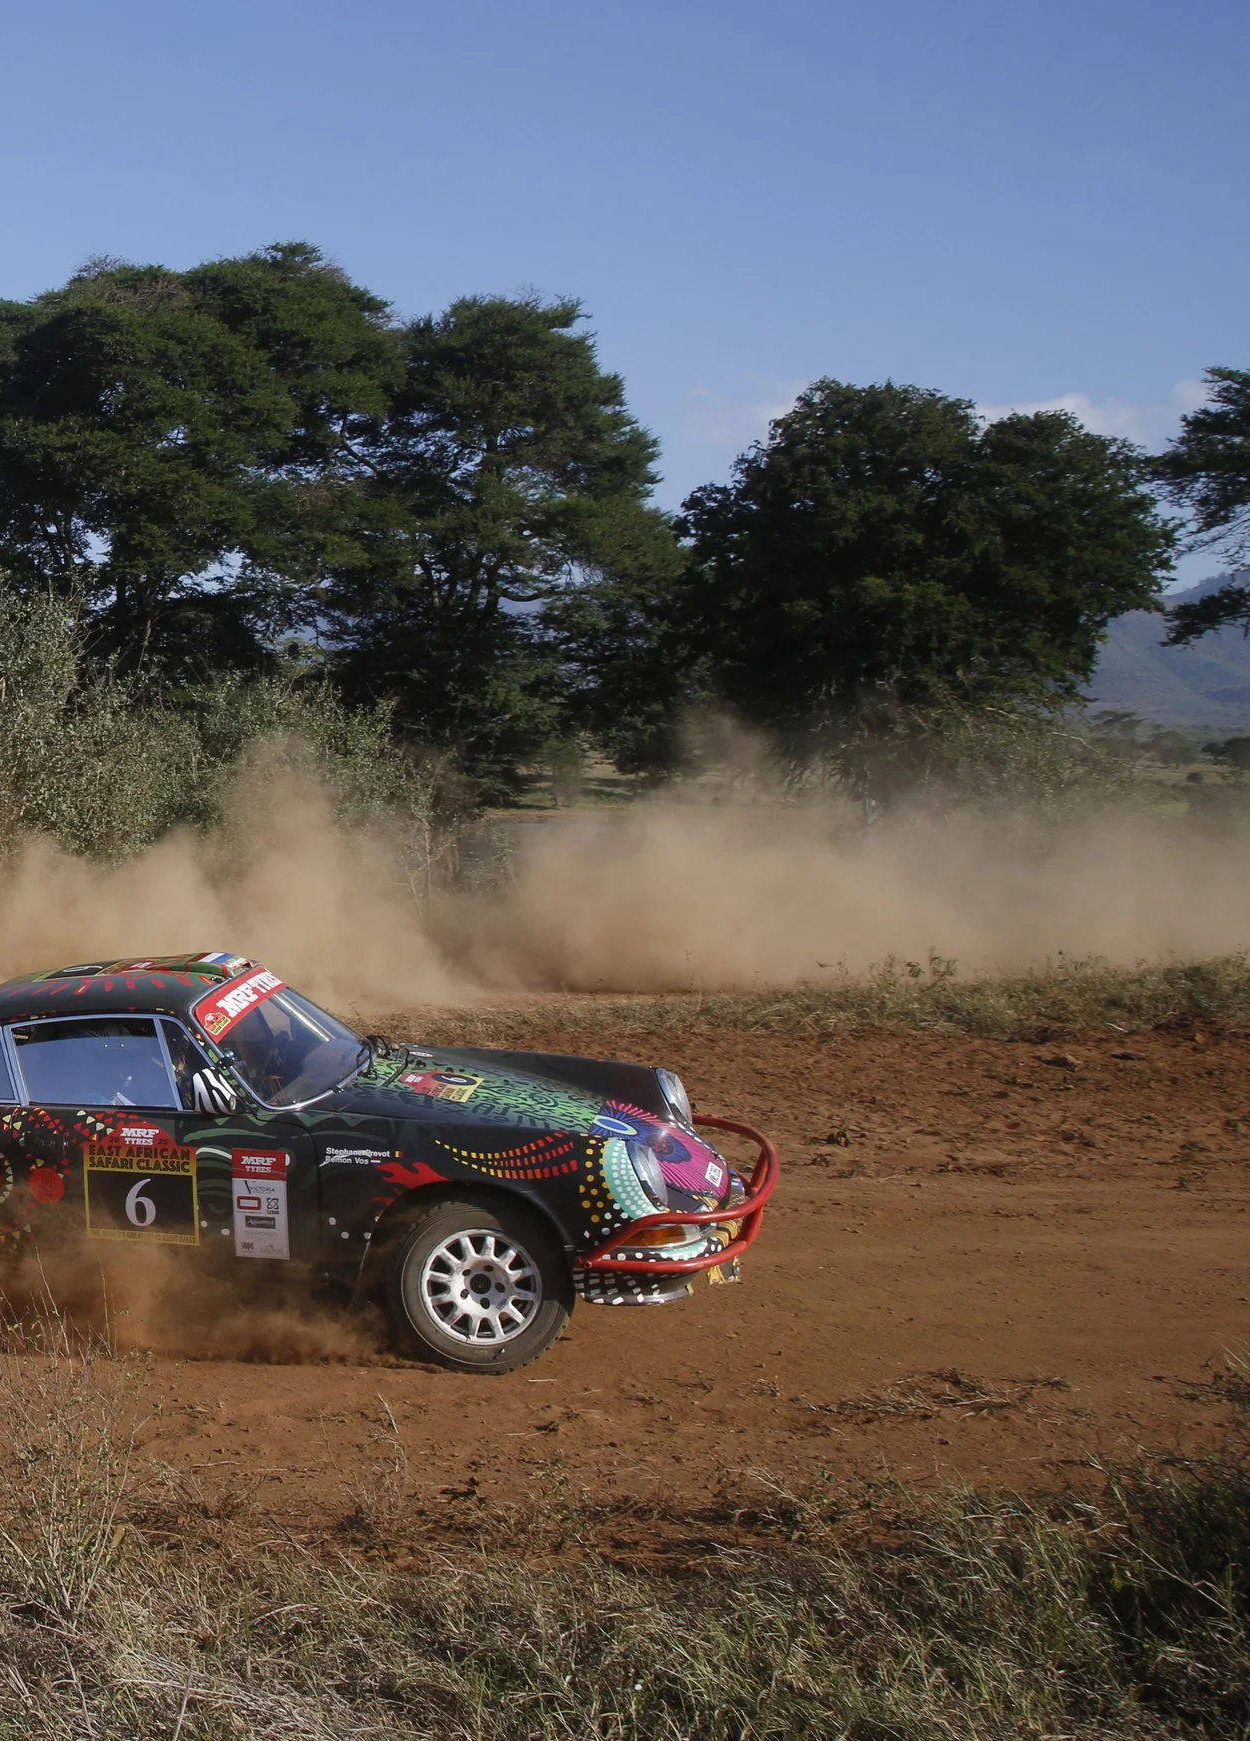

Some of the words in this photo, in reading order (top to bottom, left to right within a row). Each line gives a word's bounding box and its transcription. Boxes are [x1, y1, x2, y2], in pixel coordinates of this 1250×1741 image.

[215, 982, 260, 1018] MRF
[120, 1127, 159, 1138] MRF
[125, 1137, 154, 1145] TYRES
[89, 1145, 121, 1156] EAST
[125, 1147, 190, 1160] AFRICAN
[89, 1156, 134, 1169] SAFARI
[136, 1159, 190, 1173] CLASSIC
[240, 1156, 277, 1166] MRF
[125, 1178, 156, 1227] 6
